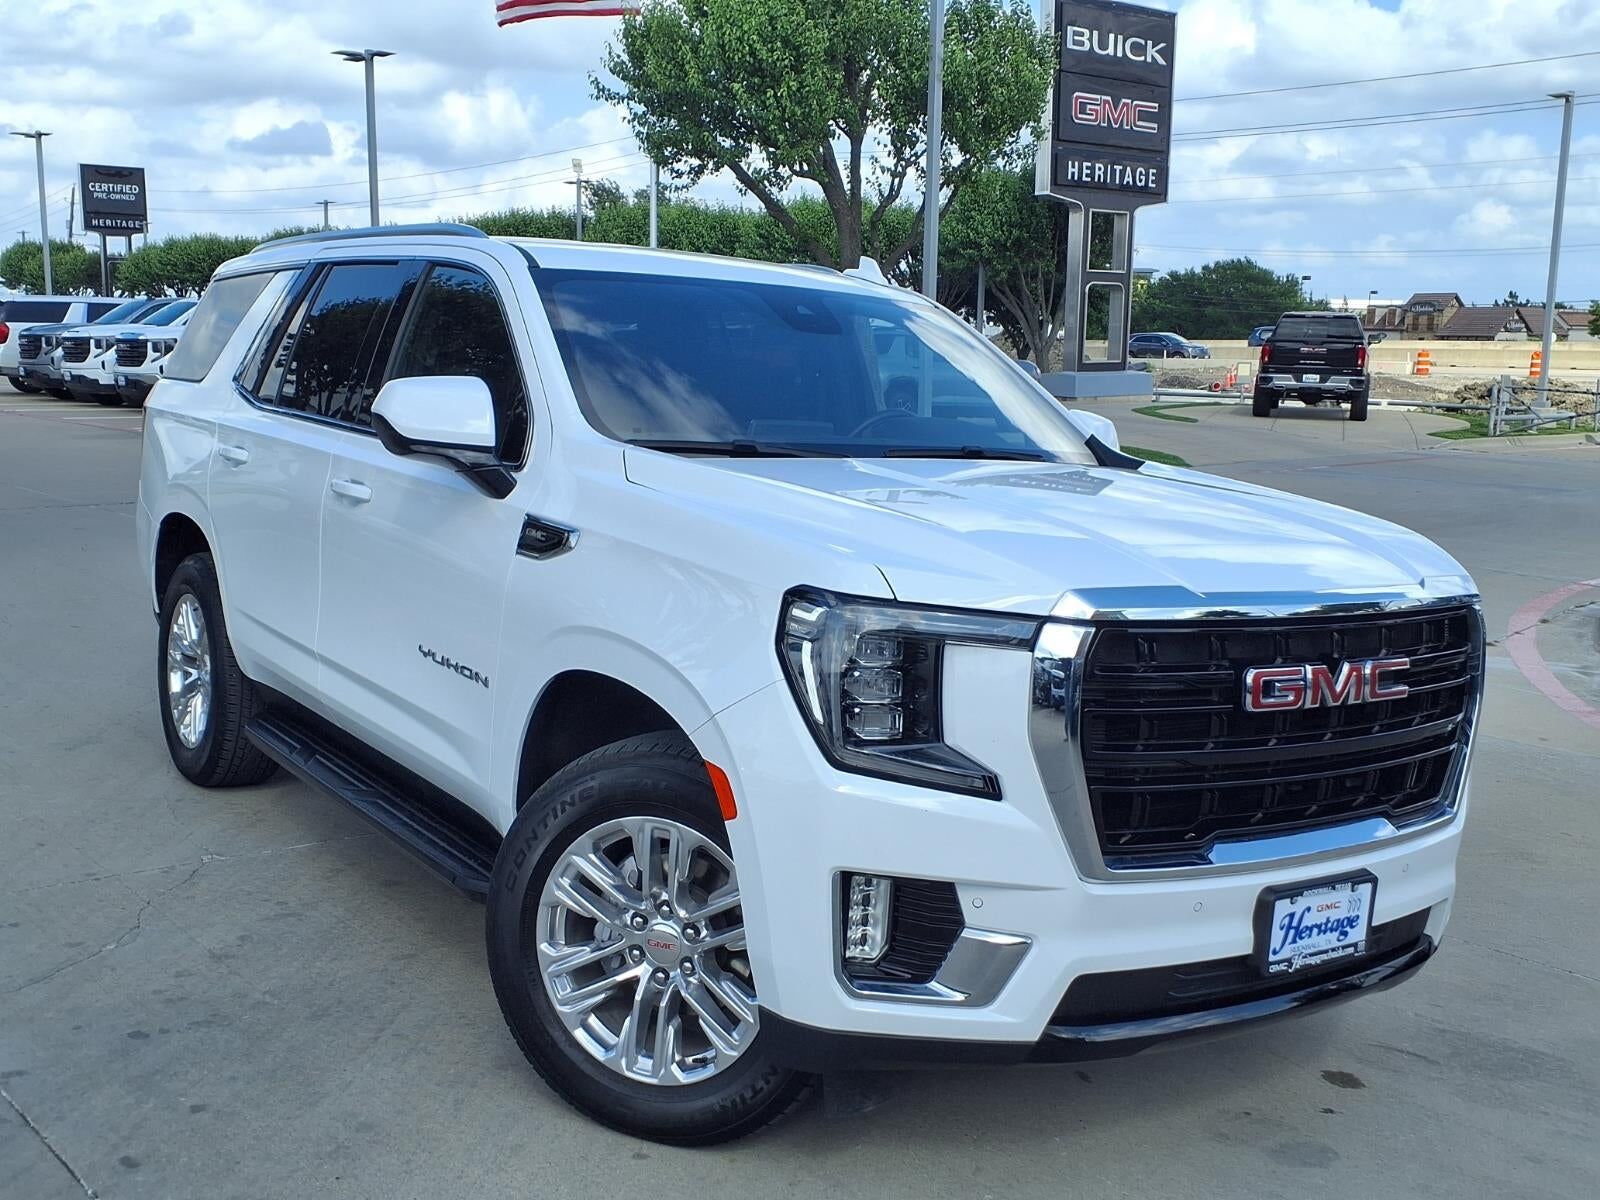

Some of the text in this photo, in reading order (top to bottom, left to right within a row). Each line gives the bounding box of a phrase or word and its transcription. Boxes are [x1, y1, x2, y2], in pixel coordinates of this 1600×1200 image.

[1066, 25, 1167, 66] BUICK
[1072, 91, 1159, 133] GMC
[88, 182, 139, 194] CERTIFIED
[1067, 160, 1157, 188] HERITAGE
[93, 192, 136, 201] PRE-OWNED
[91, 218, 141, 229] HERITAGE
[418, 643, 490, 689] YUKON
[1245, 657, 1411, 712] GMC
[1316, 900, 1342, 913] GMC
[647, 938, 677, 951] GMC
[1271, 905, 1361, 957] Heritage
